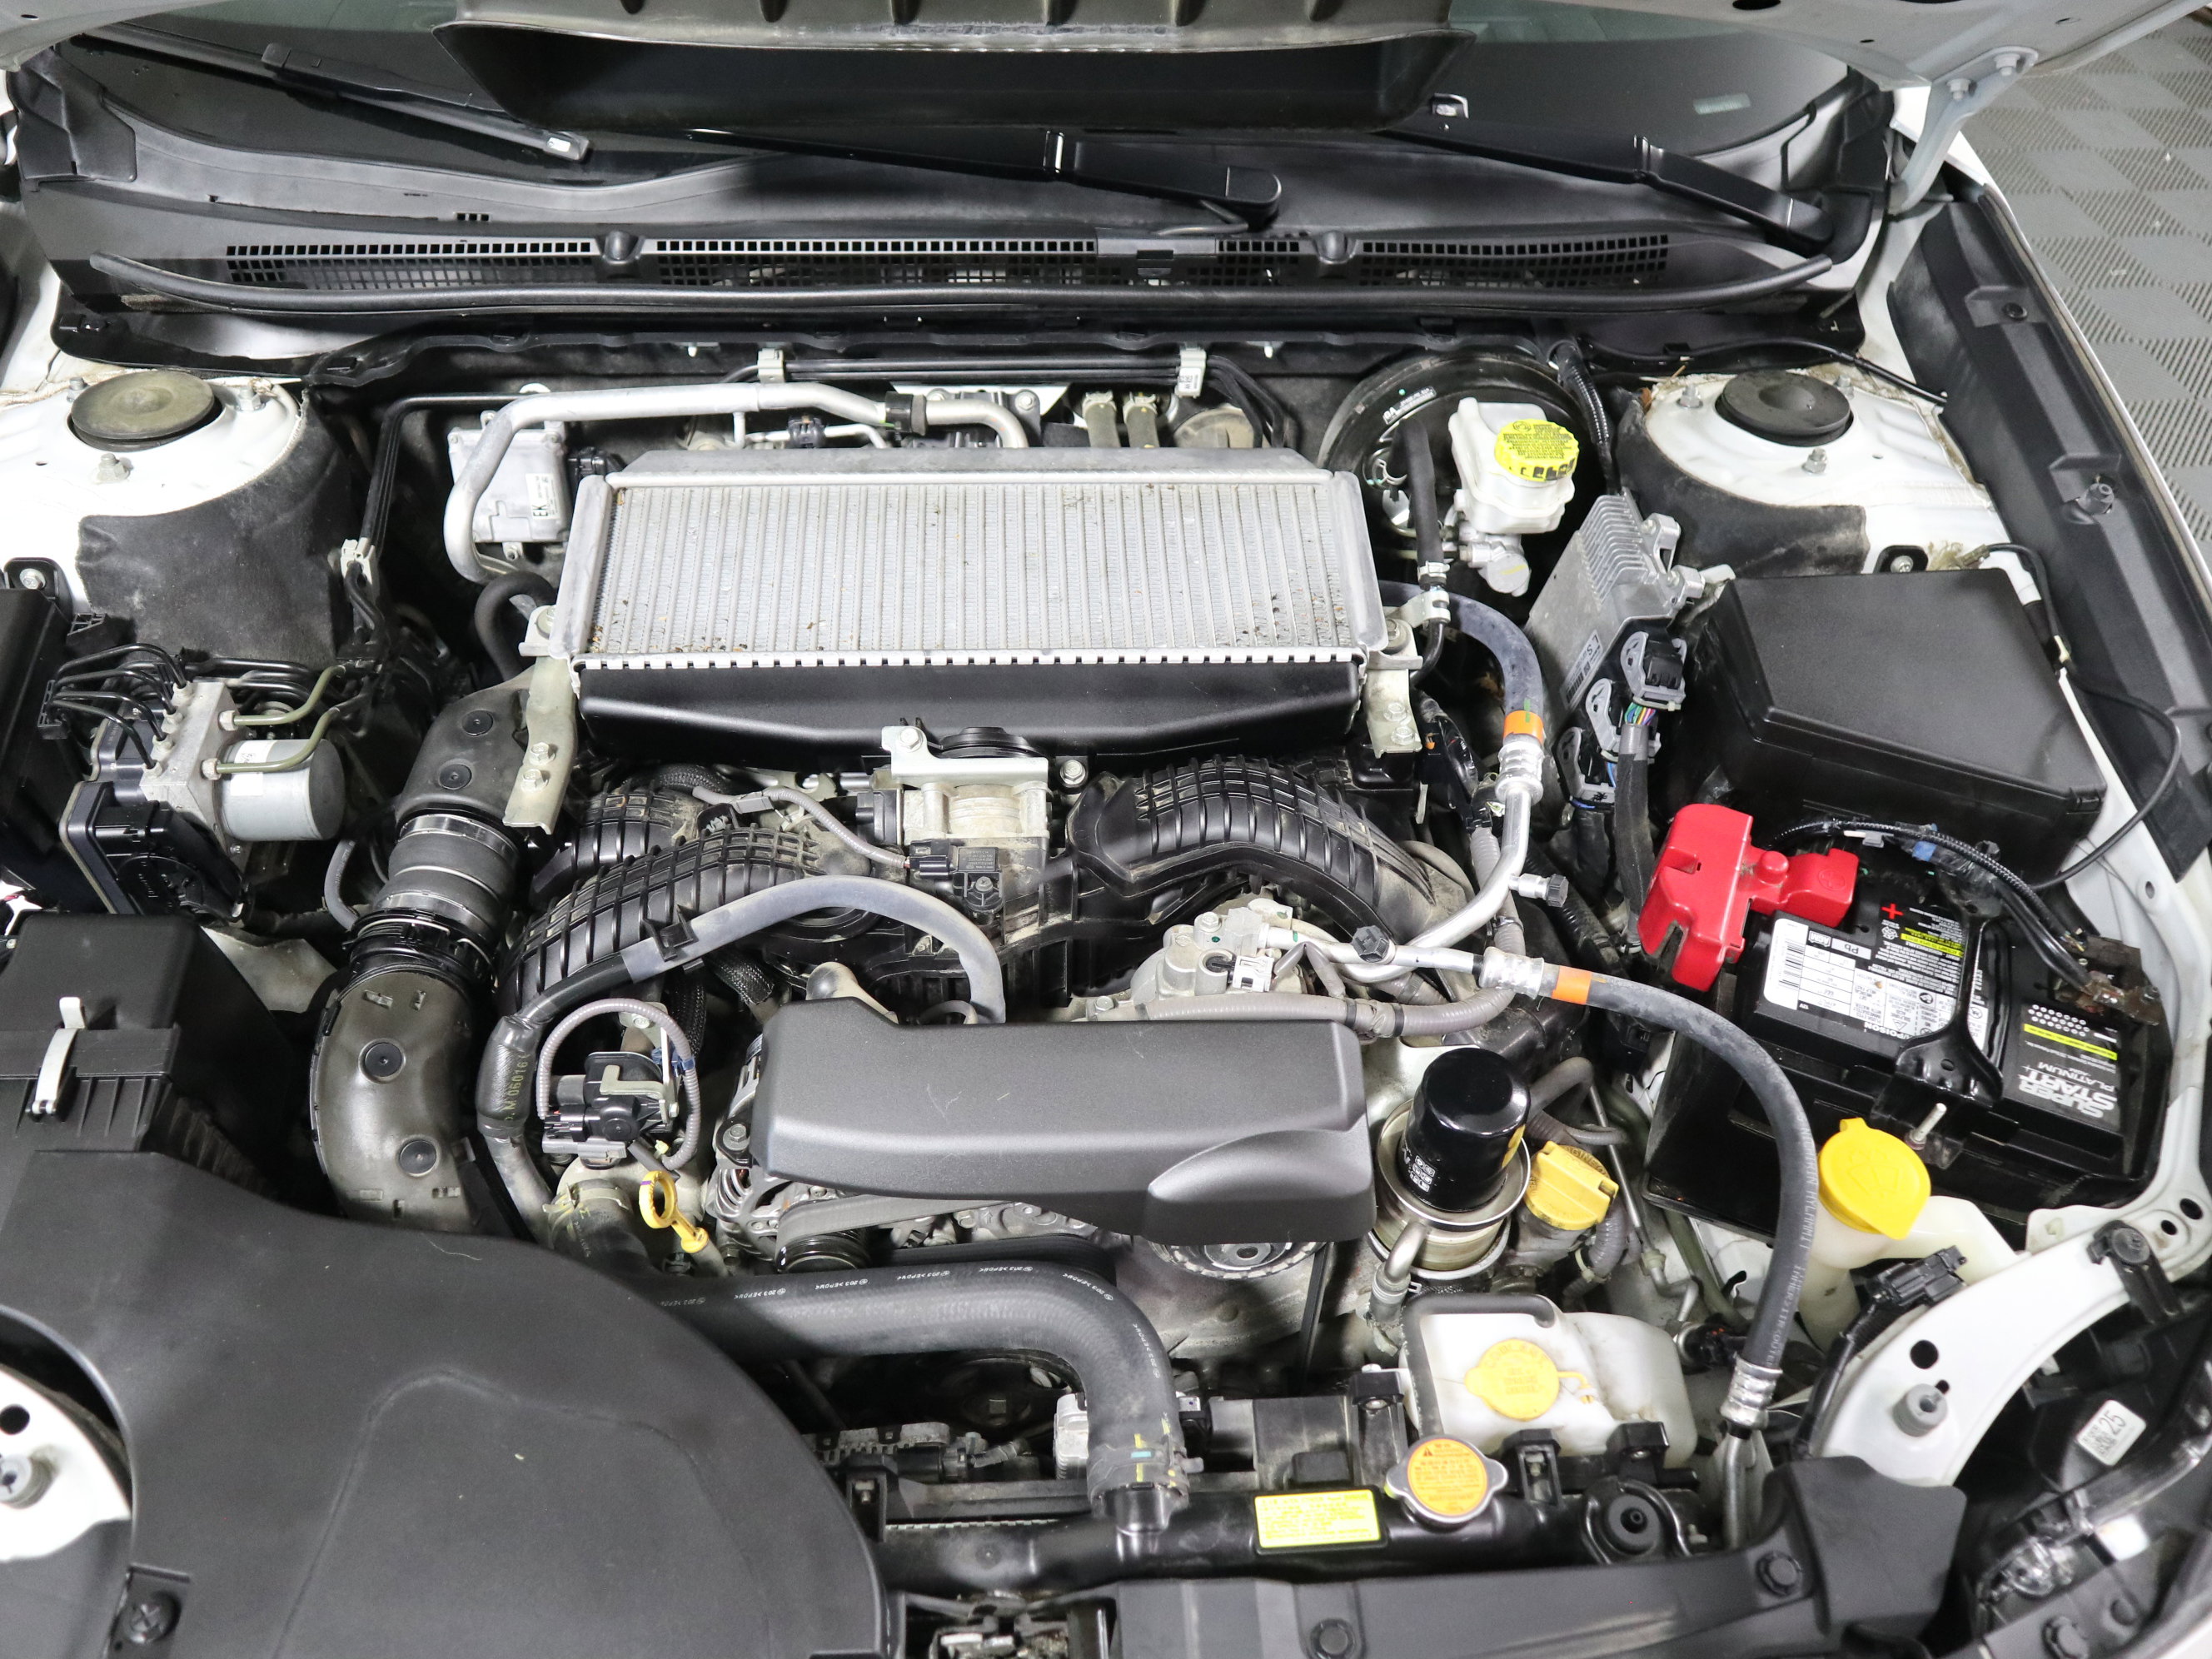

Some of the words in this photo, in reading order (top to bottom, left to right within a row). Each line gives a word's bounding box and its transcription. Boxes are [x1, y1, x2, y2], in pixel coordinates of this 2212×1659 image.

[532, 505, 549, 516] EK
[1810, 933, 1830, 944] AGM
[1844, 944, 1859, 954] Pb
[2038, 1062, 2115, 1092] PLATINUM
[2018, 1070, 2117, 1110] START
[2018, 1079, 2104, 1118] SUPER
[2099, 1410, 2125, 1435] 25
